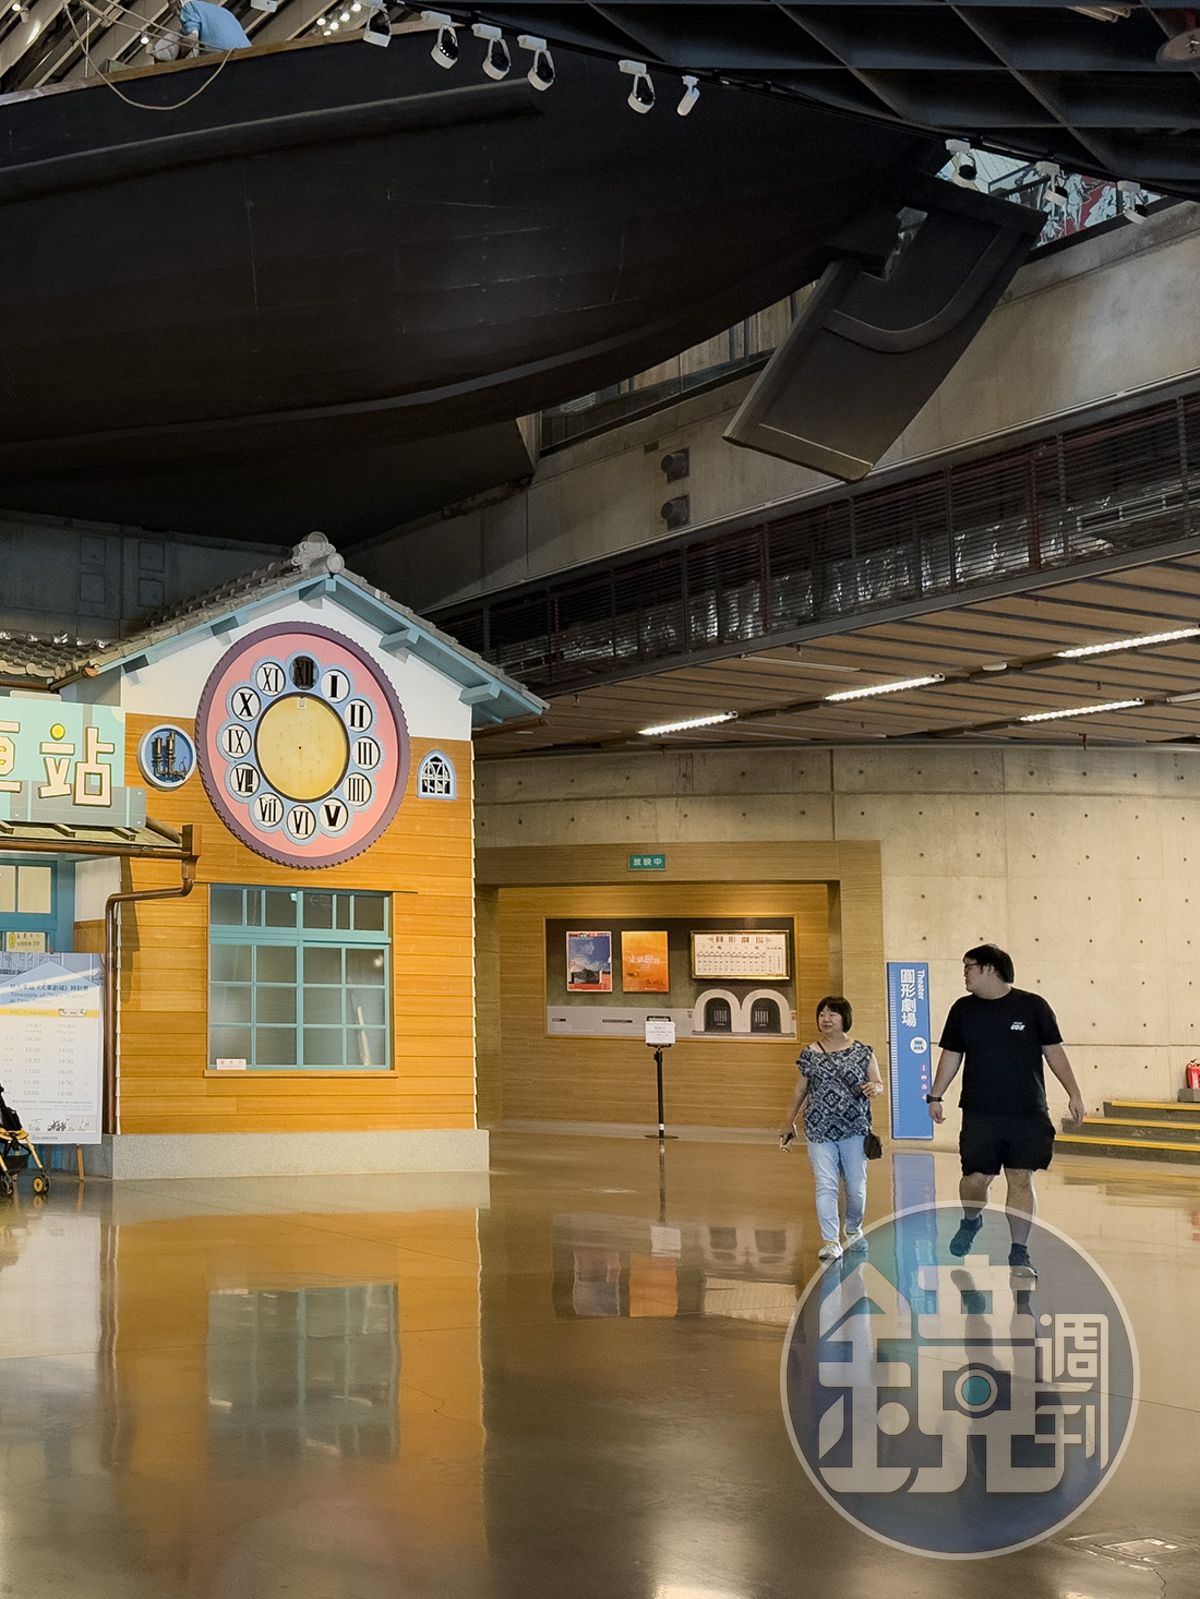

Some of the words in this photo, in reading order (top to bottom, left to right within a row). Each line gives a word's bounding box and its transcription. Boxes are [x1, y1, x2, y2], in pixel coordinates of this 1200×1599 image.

[239, 693, 253, 717] X
[350, 704, 364, 728] II
[228, 729, 244, 754] IX
[358, 741, 373, 765] III
[325, 805, 341, 827] V
[632, 857, 662, 866] 放映中
[900, 969, 917, 1027] 圓形劇場
